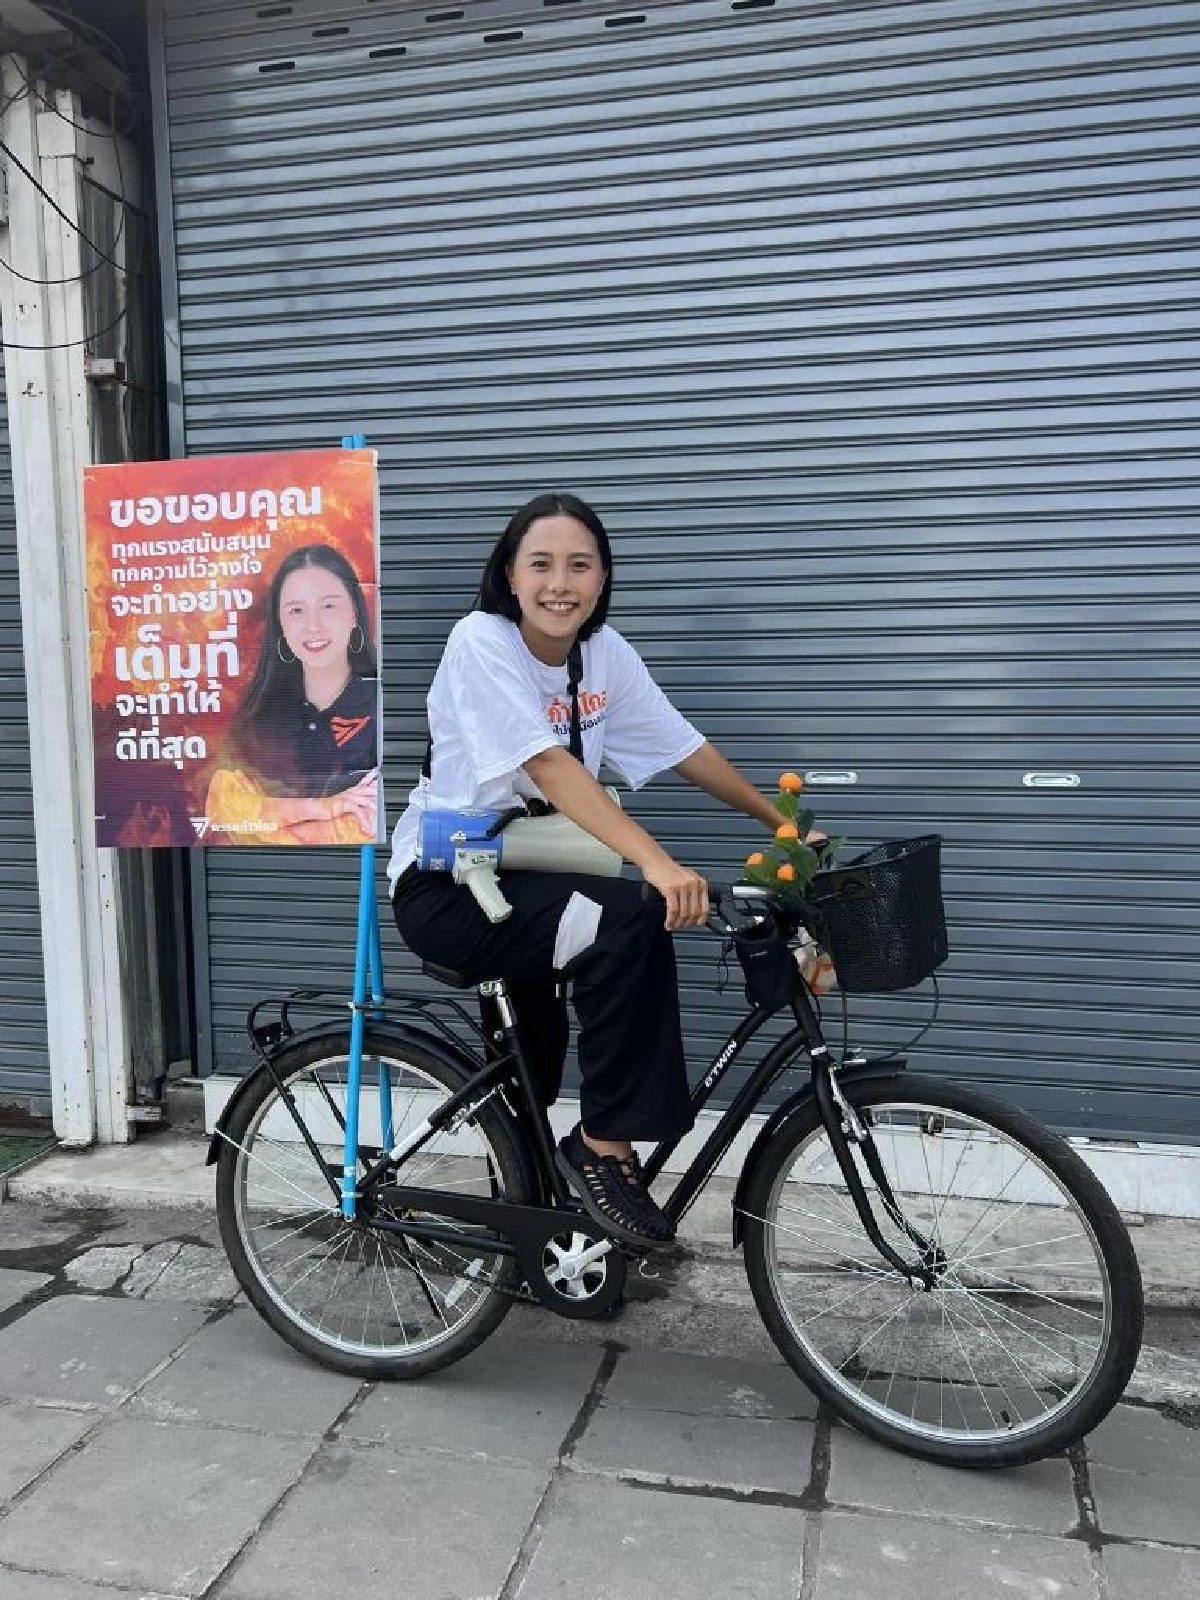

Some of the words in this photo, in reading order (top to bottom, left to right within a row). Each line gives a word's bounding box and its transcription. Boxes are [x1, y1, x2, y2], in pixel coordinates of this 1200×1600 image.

[110, 486, 322, 531] ขอขอบคุณ
[111, 532, 271, 564] ทุกแรงสนับสนุน
[111, 552, 262, 587] ทุกความไว้วางใจ
[111, 580, 253, 617] จะทำอย่าง
[114, 612, 239, 681] เต็มที่
[116, 679, 222, 717] จะทำให้
[116, 716, 206, 770] ดีที่สุด
